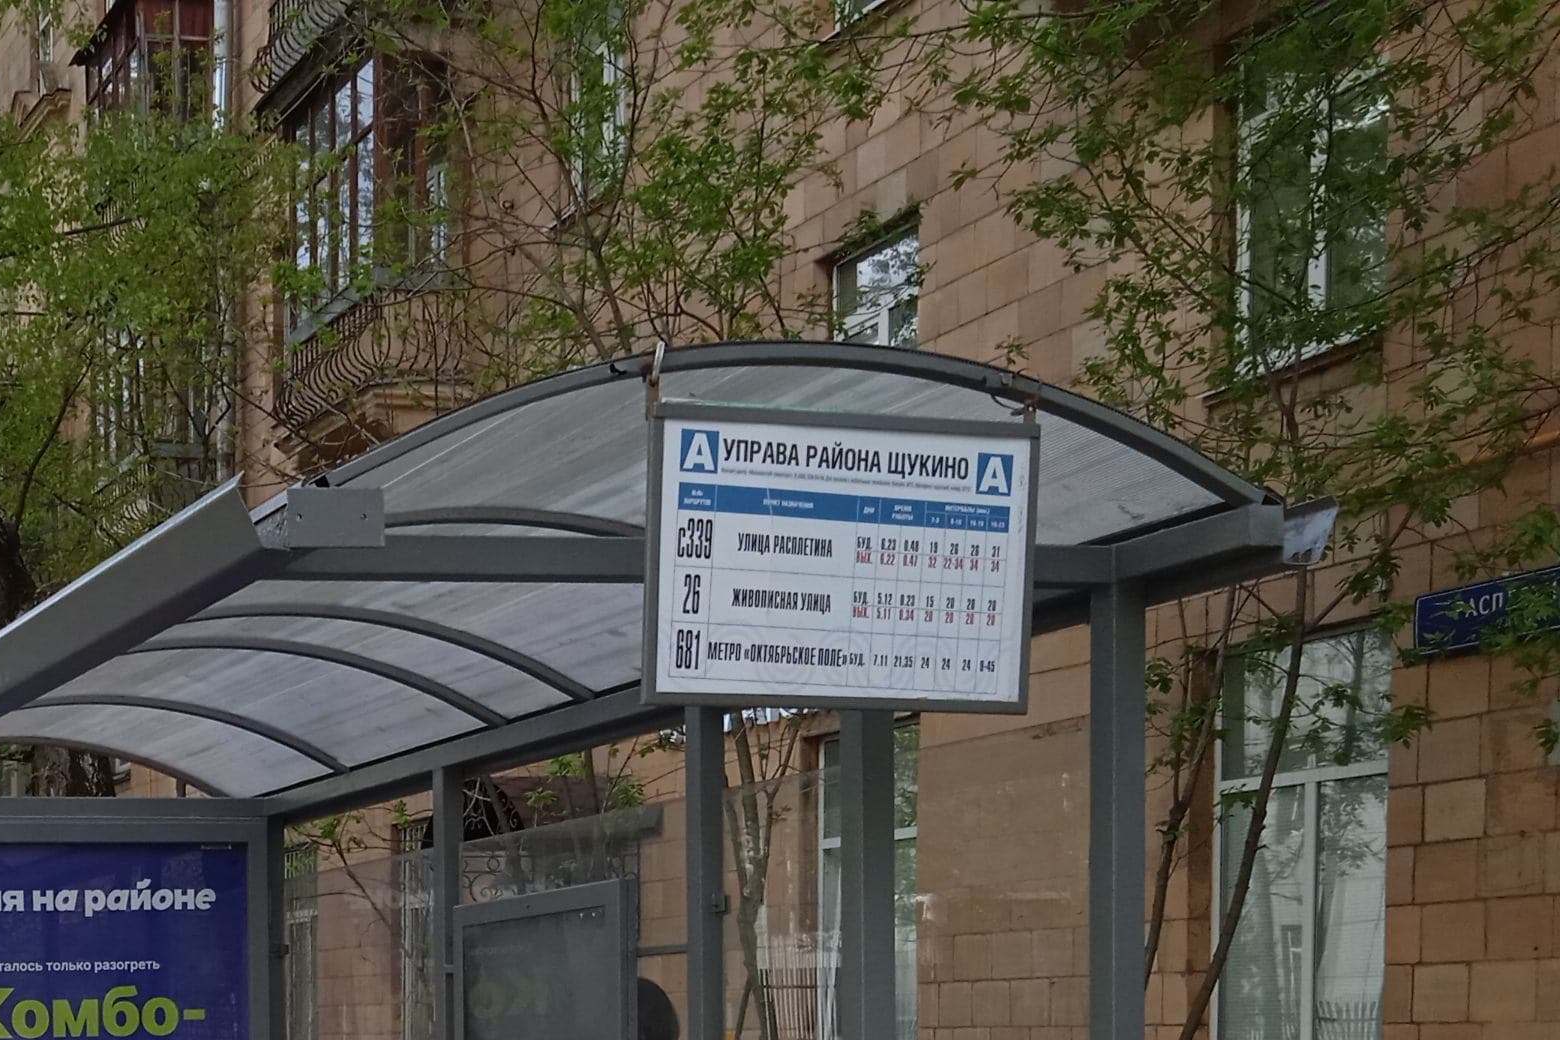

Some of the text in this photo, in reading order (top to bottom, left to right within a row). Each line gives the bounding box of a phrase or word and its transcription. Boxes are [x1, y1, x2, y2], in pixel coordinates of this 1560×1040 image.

[723, 438, 969, 480] УПРАВА РАЙОНА ЩУКИНО
[738, 532, 833, 558] УЛИЦА РАСПЛЕТИНА
[682, 573, 701, 614] 26
[732, 588, 831, 615] ЖИВОПИСНАЯ УЛИЦА
[675, 629, 701, 670] 681
[707, 641, 847, 667] МЕТРО «ОКТЯБРЬСКОЕ ПОЛЕ»
[921, 656, 930, 669] 24
[942, 657, 951, 670] 24
[962, 659, 971, 671] 24
[32, 889, 79, 912] на
[84, 878, 217, 917] районе
[46, 961, 92, 972] только
[94, 960, 160, 973] разогреть
